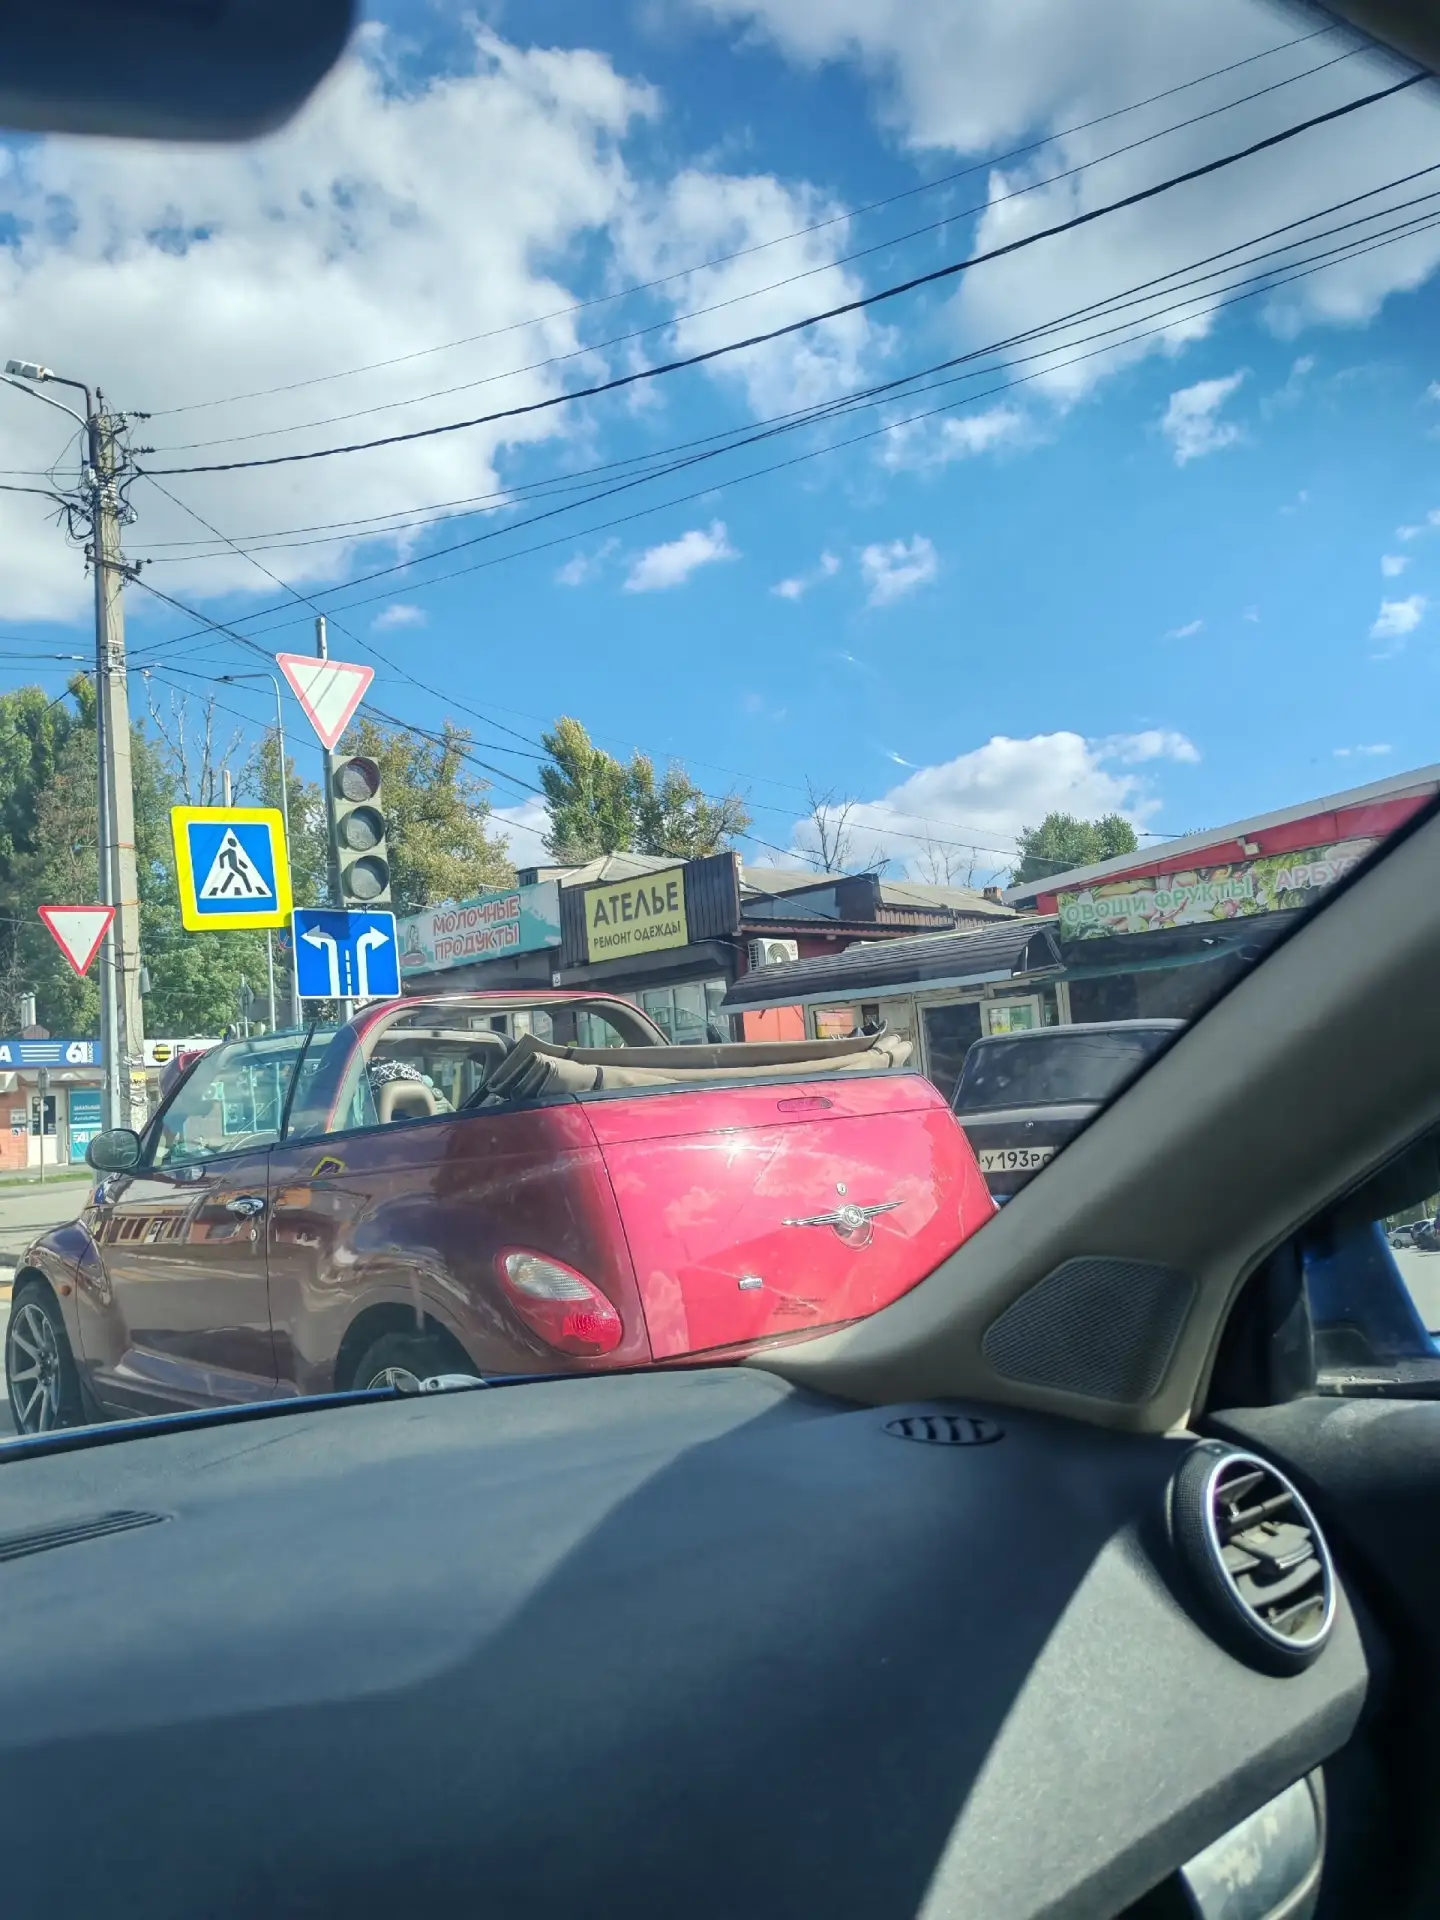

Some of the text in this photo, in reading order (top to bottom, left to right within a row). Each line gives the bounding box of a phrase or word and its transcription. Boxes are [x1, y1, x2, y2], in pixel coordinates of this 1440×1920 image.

[433, 896, 519, 936] МОЛОЧНЫЕ
[594, 882, 679, 928] АТЕЛЬЕ
[1066, 895, 1146, 923] ОВОЩИ
[1154, 877, 1252, 908] ФРУКТЫ
[434, 924, 519, 960] ПРОДУКТЫ
[594, 920, 681, 950] РЕМОНТ ОДЕЖДЫ
